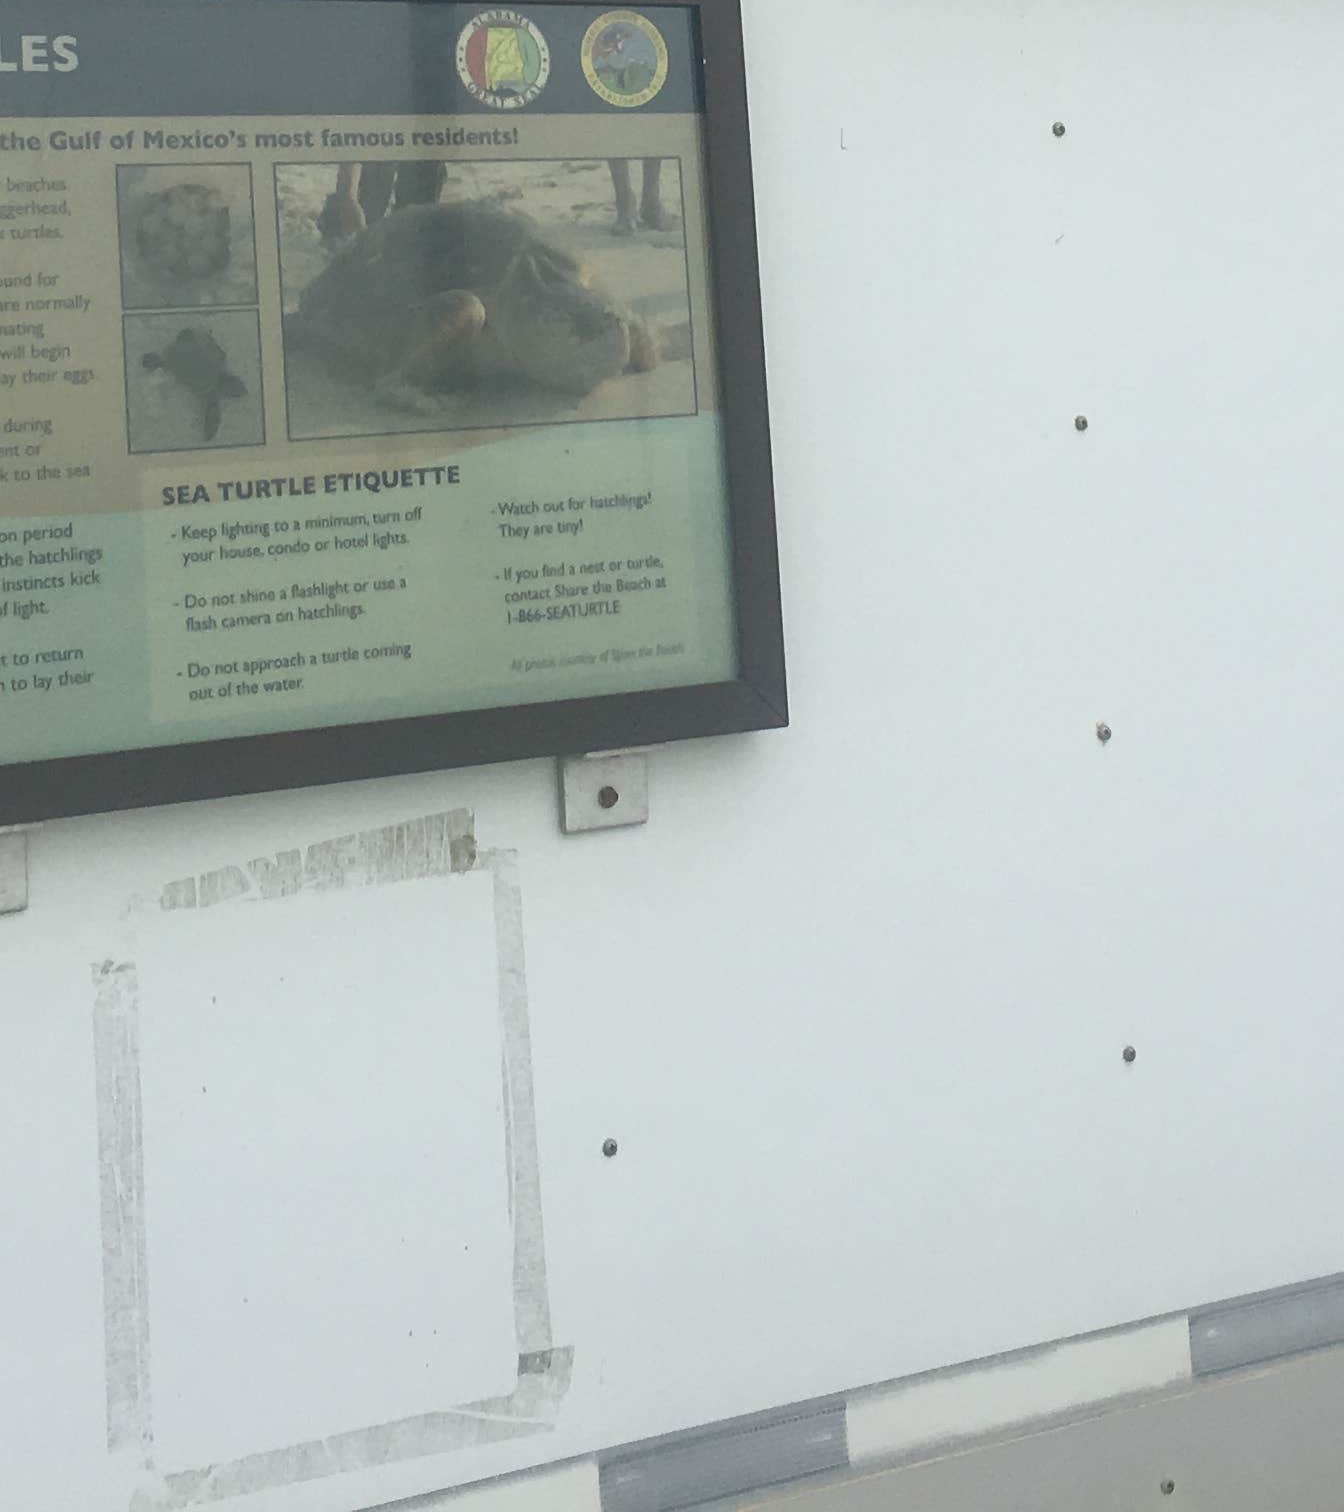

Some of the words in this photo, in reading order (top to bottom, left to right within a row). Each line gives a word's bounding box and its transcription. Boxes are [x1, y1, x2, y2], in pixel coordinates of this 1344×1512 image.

[48, 129, 102, 151] Gulf
[108, 129, 135, 150] of
[142, 129, 247, 150] Mexico's
[254, 130, 315, 149] most
[320, 128, 406, 148] famous
[410, 126, 518, 147] residents!
[161, 483, 211, 506] SEA
[216, 475, 317, 502] TURTLE
[322, 464, 461, 494] ETIQUETTE
[21, 521, 74, 546] period
[180, 524, 218, 543] Keep
[220, 520, 271, 541] lighting
[272, 520, 290, 533] to
[292, 519, 302, 532] a
[371, 511, 402, 525] turn
[403, 505, 423, 522] off
[497, 522, 530, 540] They
[532, 523, 554, 536] are
[555, 517, 584, 536] tiny!
[27, 546, 103, 565] hatchlings
[181, 549, 215, 568] your
[266, 538, 311, 556] condo
[313, 539, 331, 552] or
[332, 531, 369, 550] hotel
[371, 530, 410, 550] lights.
[1, 575, 66, 593] instincts
[69, 568, 101, 587] kick
[183, 593, 208, 610] Do
[210, 593, 236, 607] not
[238, 588, 276, 604] shine
[278, 588, 288, 601] a
[290, 580, 350, 601] flashlight
[351, 580, 370, 593] or
[372, 578, 396, 592] use
[398, 577, 407, 589] a
[184, 614, 218, 632] flash
[220, 612, 272, 629] camera
[274, 610, 295, 623] on
[12, 652, 30, 666] to
[33, 648, 84, 664] return
[186, 661, 212, 679] Do
[213, 660, 239, 675] not
[242, 651, 307, 677] approach
[308, 654, 318, 666] a
[320, 646, 360, 665] turtle
[362, 643, 412, 660] coming
[188, 687, 214, 701] out
[216, 681, 232, 698] of
[235, 680, 259, 696] the
